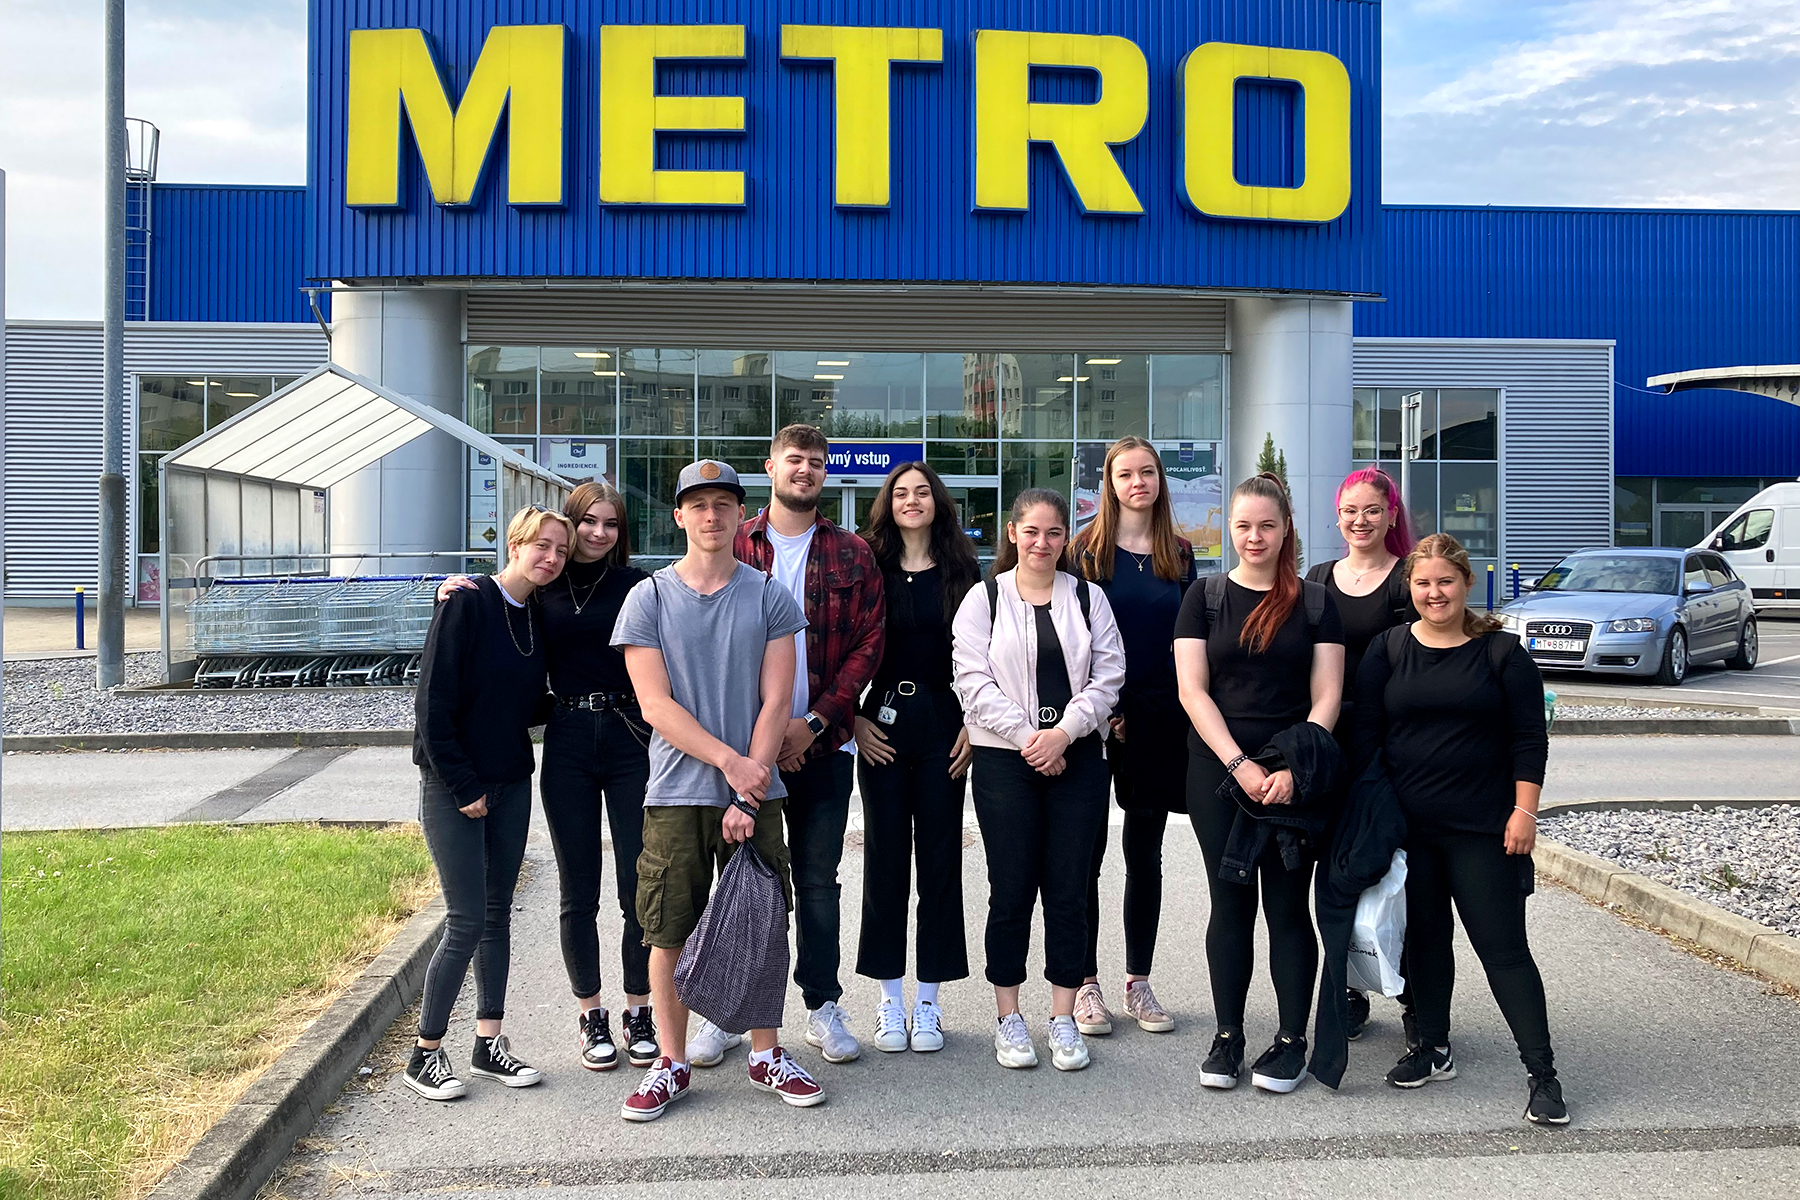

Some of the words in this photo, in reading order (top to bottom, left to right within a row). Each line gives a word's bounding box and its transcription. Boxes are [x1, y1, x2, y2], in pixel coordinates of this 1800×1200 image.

[346, 24, 1351, 222] METRO
[825, 450, 851, 468] vný
[854, 451, 890, 468] vstup
